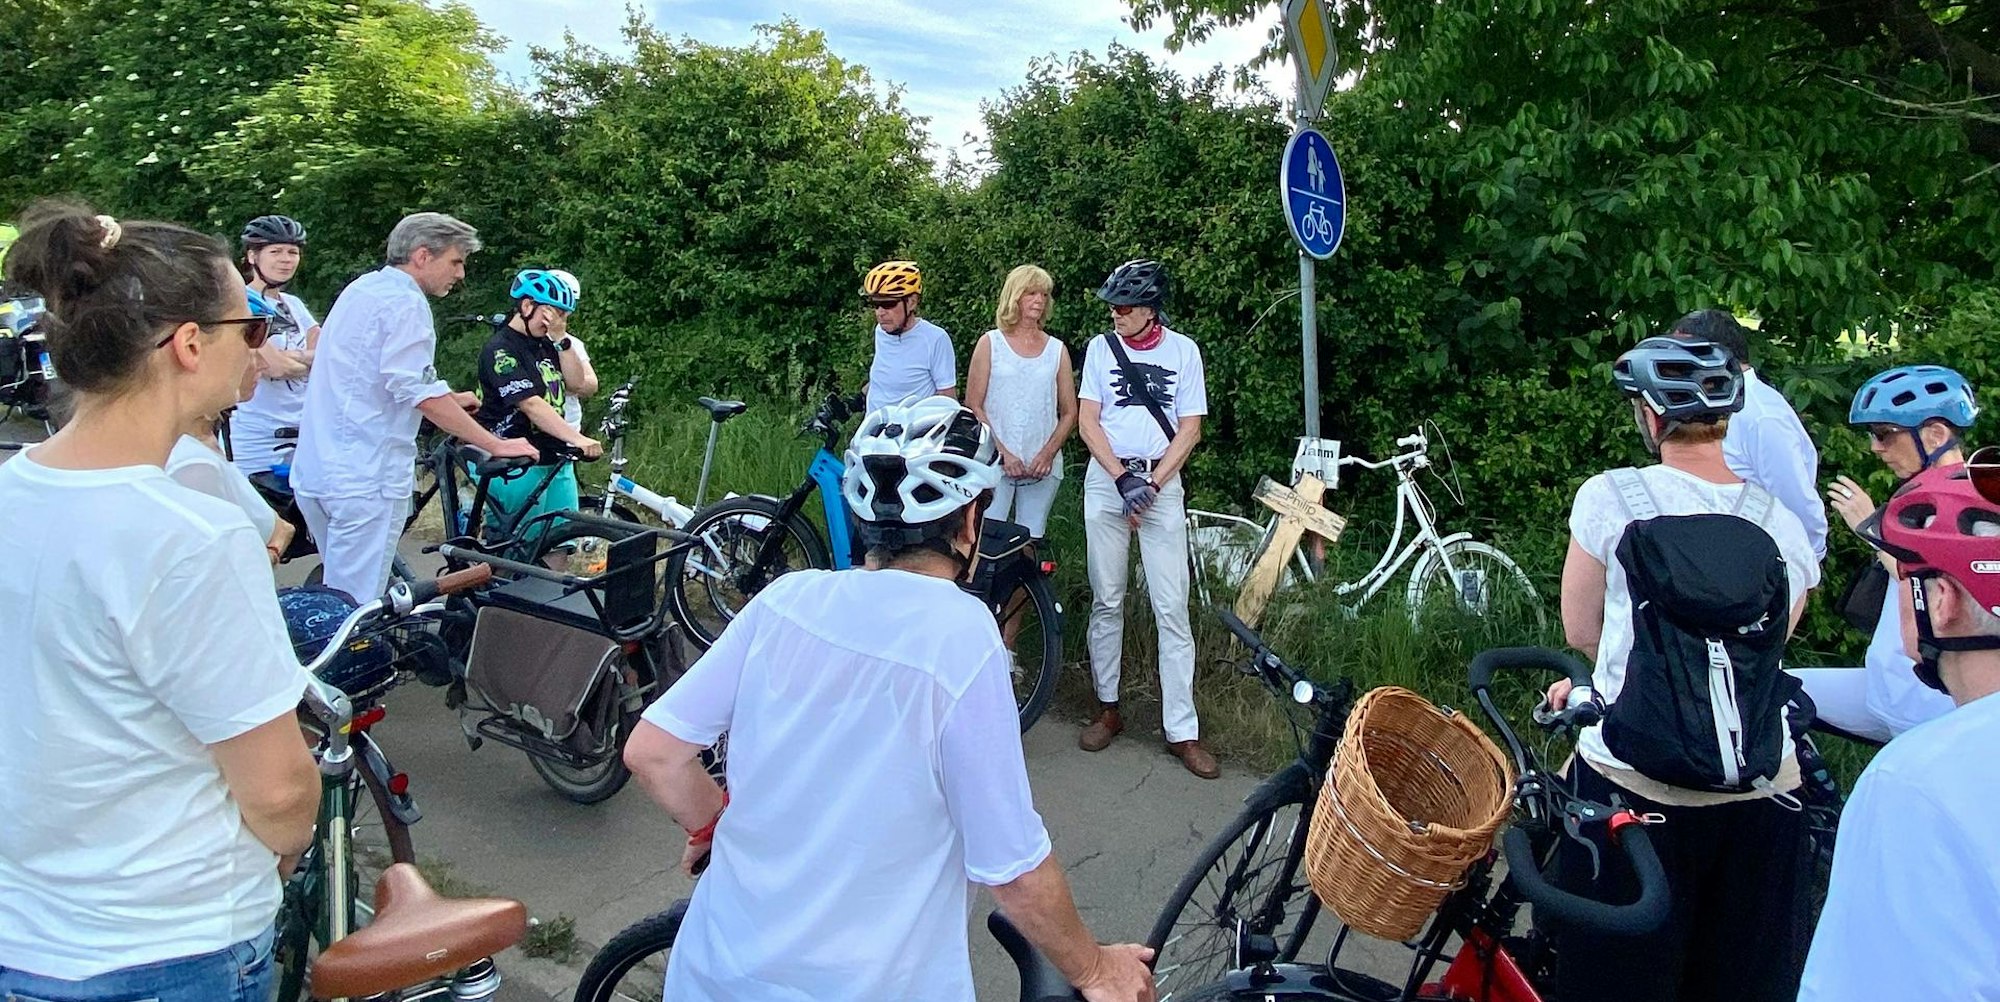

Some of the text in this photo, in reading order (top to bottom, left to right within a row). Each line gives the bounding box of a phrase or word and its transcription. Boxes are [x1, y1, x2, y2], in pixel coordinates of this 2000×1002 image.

[942, 480, 973, 498] KED
[1286, 492, 1316, 515] Philip
[1976, 563, 2000, 571] ABU
[1911, 576, 1925, 611] ACE
